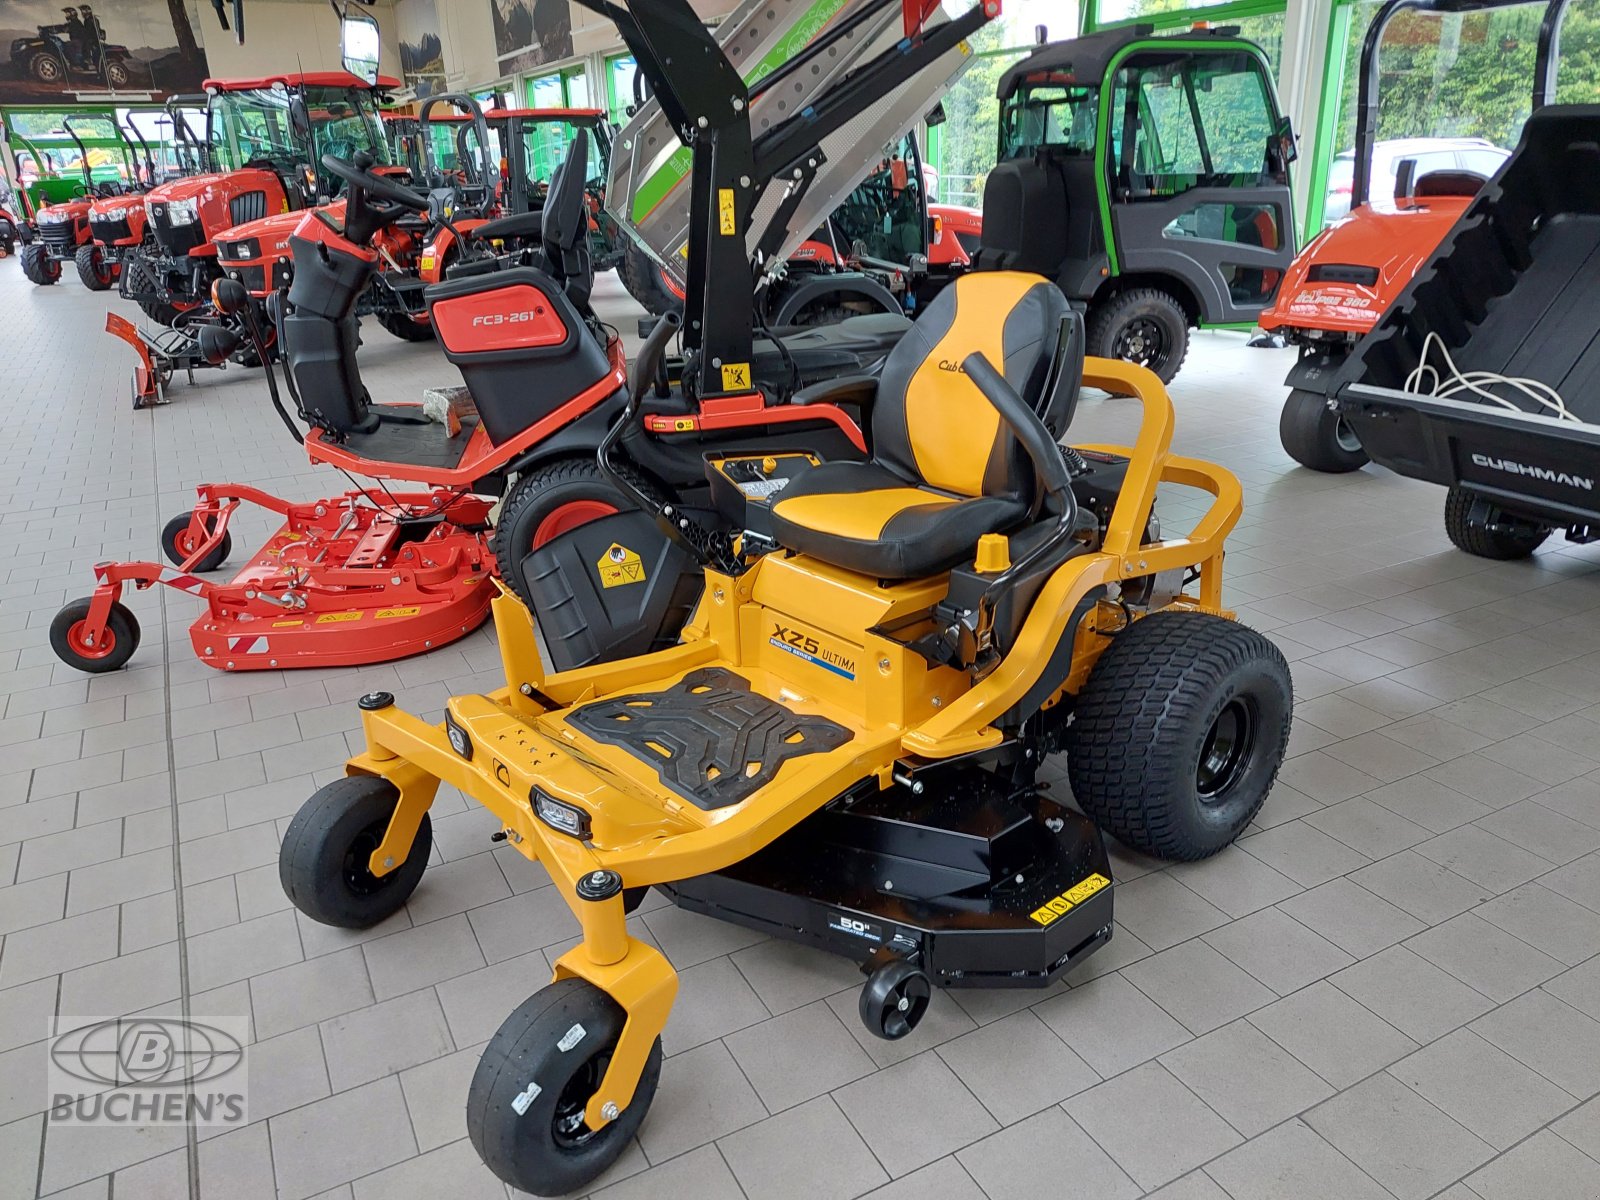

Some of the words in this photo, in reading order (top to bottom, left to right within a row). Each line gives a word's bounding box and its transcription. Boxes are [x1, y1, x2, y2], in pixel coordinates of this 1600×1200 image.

[472, 311, 535, 327] FC3-261
[938, 359, 958, 372] Cub
[1471, 453, 1593, 491] CUSHMAN
[770, 638, 792, 652] ENDURO
[772, 623, 820, 655] XZ5
[822, 648, 855, 672] ULTIMA
[840, 916, 870, 932] 50"
